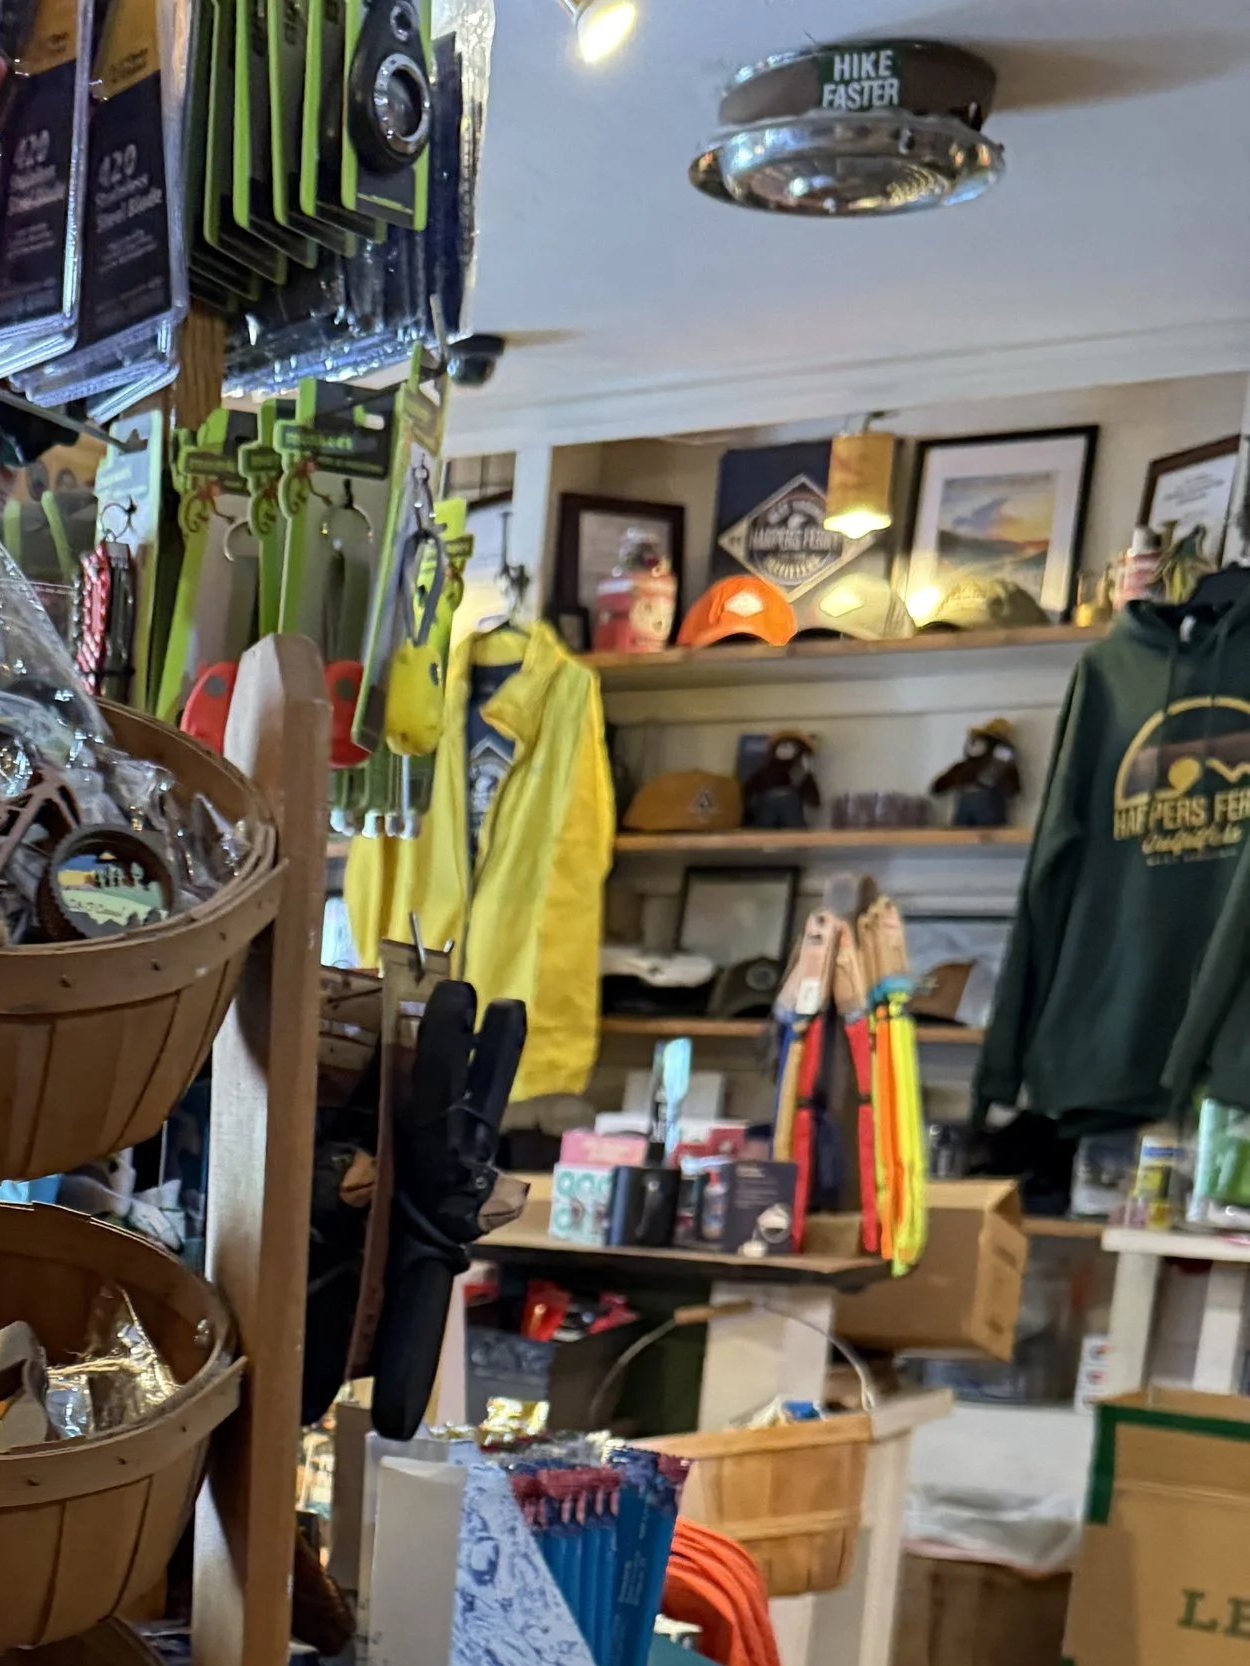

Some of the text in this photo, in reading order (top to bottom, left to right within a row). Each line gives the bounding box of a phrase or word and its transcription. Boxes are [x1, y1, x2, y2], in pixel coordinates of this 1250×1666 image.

[833, 50, 893, 81] HIKE
[821, 78, 900, 110] FASTER
[99, 143, 138, 187] 420
